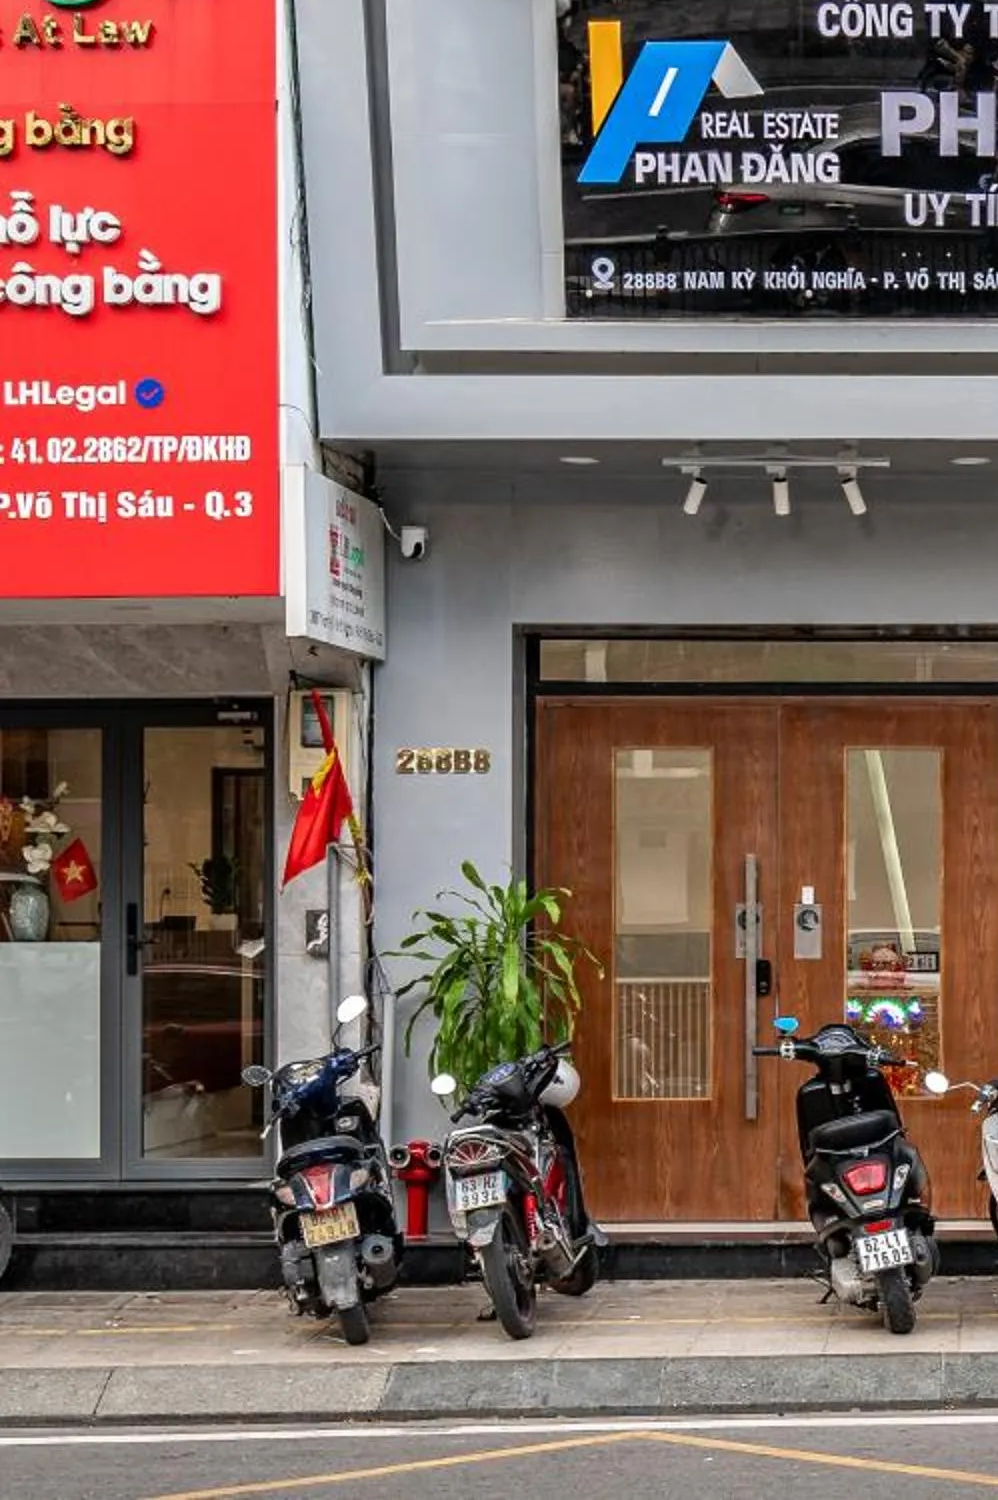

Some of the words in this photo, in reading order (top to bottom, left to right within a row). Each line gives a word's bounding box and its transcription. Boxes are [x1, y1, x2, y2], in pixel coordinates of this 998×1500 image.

[13, 12, 61, 44] At
[73, 12, 152, 44] Law
[924, 3, 971, 38] TY
[26, 102, 133, 155] bằng
[701, 112, 755, 139] REAL
[763, 112, 839, 139] ESTATE
[634, 152, 733, 184] PHAN
[740, 143, 842, 184] ĐĂNG
[904, 193, 951, 227] UY
[49, 204, 121, 254] lực
[0, 261, 95, 316] ông
[103, 248, 222, 315] bằng
[684, 271, 725, 289] NAM
[731, 266, 756, 289] KỲ
[764, 264, 805, 290] KHỞI
[812, 266, 867, 289] NGHĨA
[905, 267, 930, 289] VÕ
[937, 271, 966, 293] THỊ
[4, 379, 127, 412] LHLegal
[61, 491, 107, 523] Thị
[117, 490, 173, 518] Sáu
